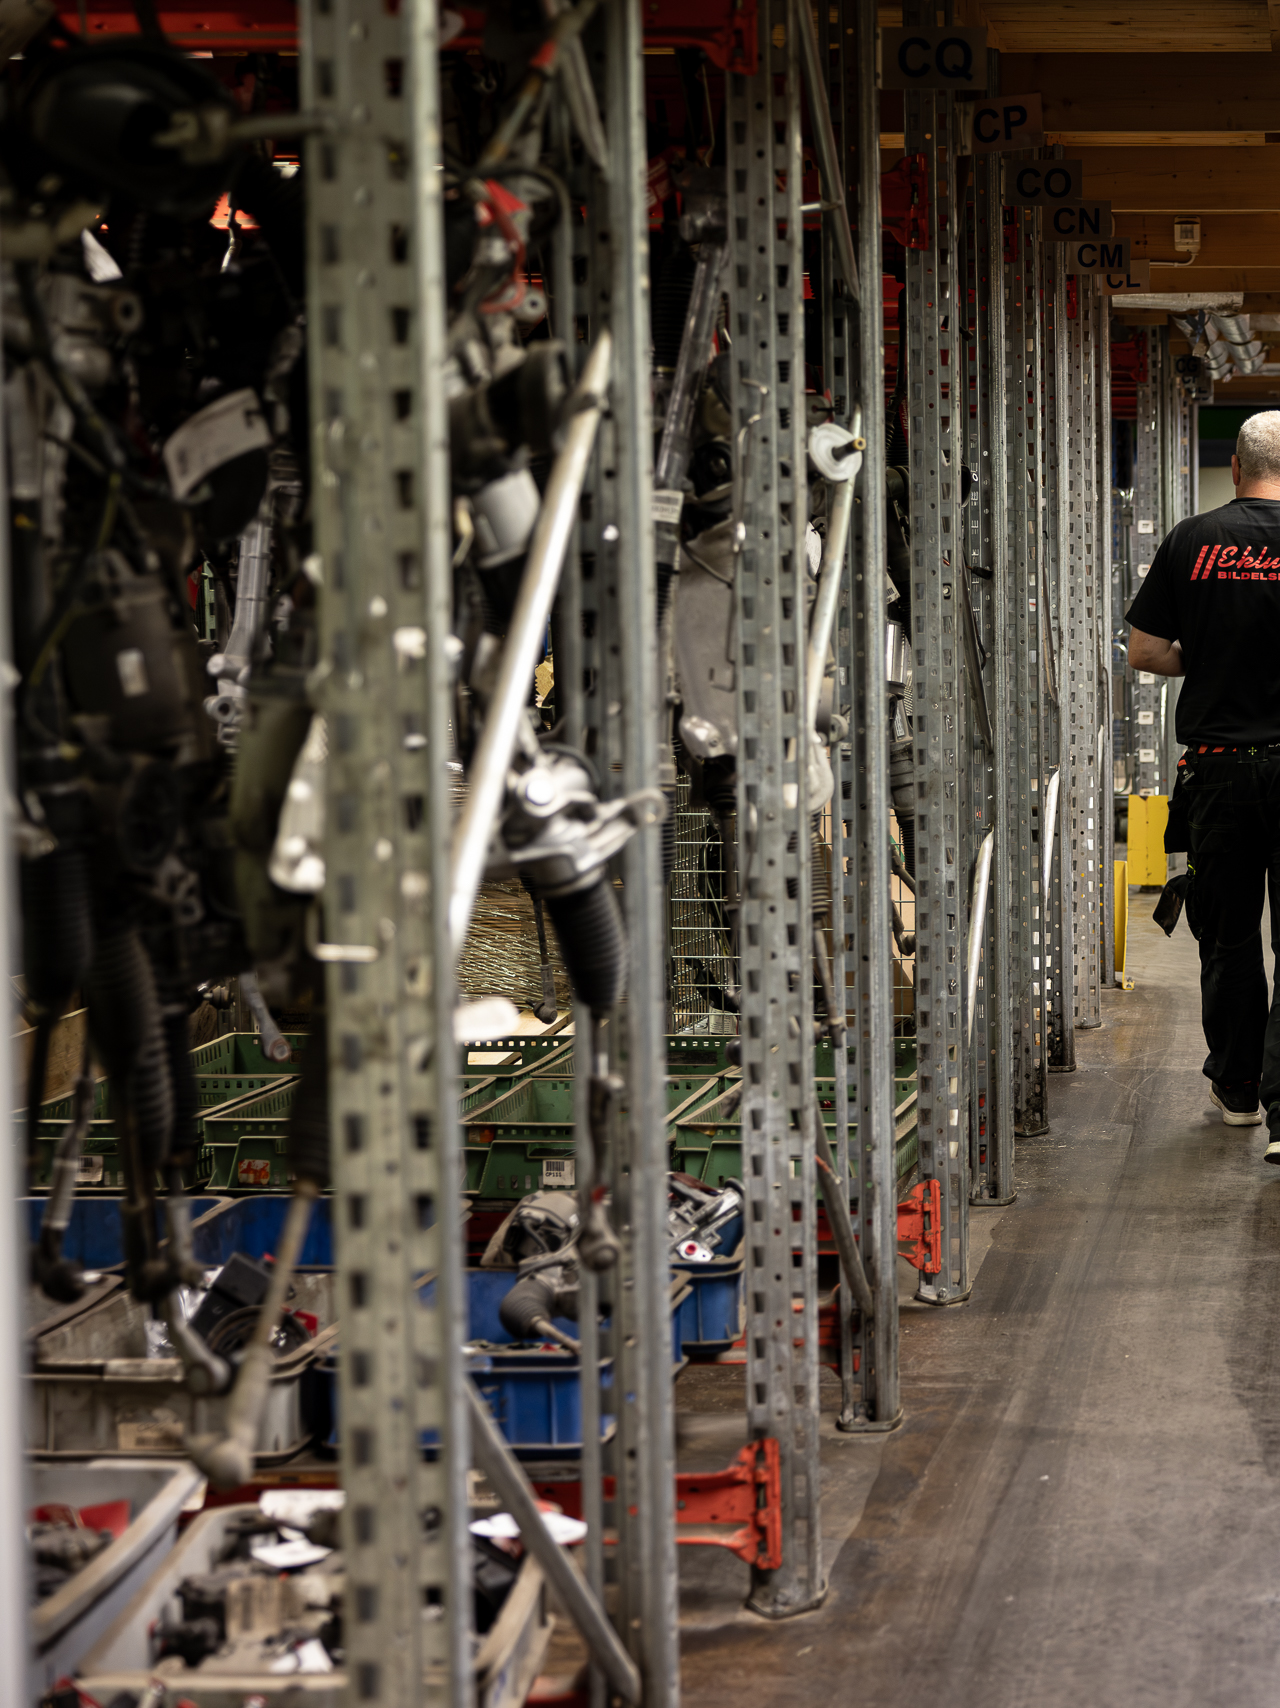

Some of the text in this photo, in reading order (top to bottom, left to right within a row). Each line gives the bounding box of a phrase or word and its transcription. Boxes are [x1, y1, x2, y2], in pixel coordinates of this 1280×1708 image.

[898, 37, 974, 81] CQ
[973, 104, 1028, 144] CP
[1015, 167, 1072, 199] CO
[1053, 207, 1101, 235] CN
[1077, 243, 1124, 269] CM
